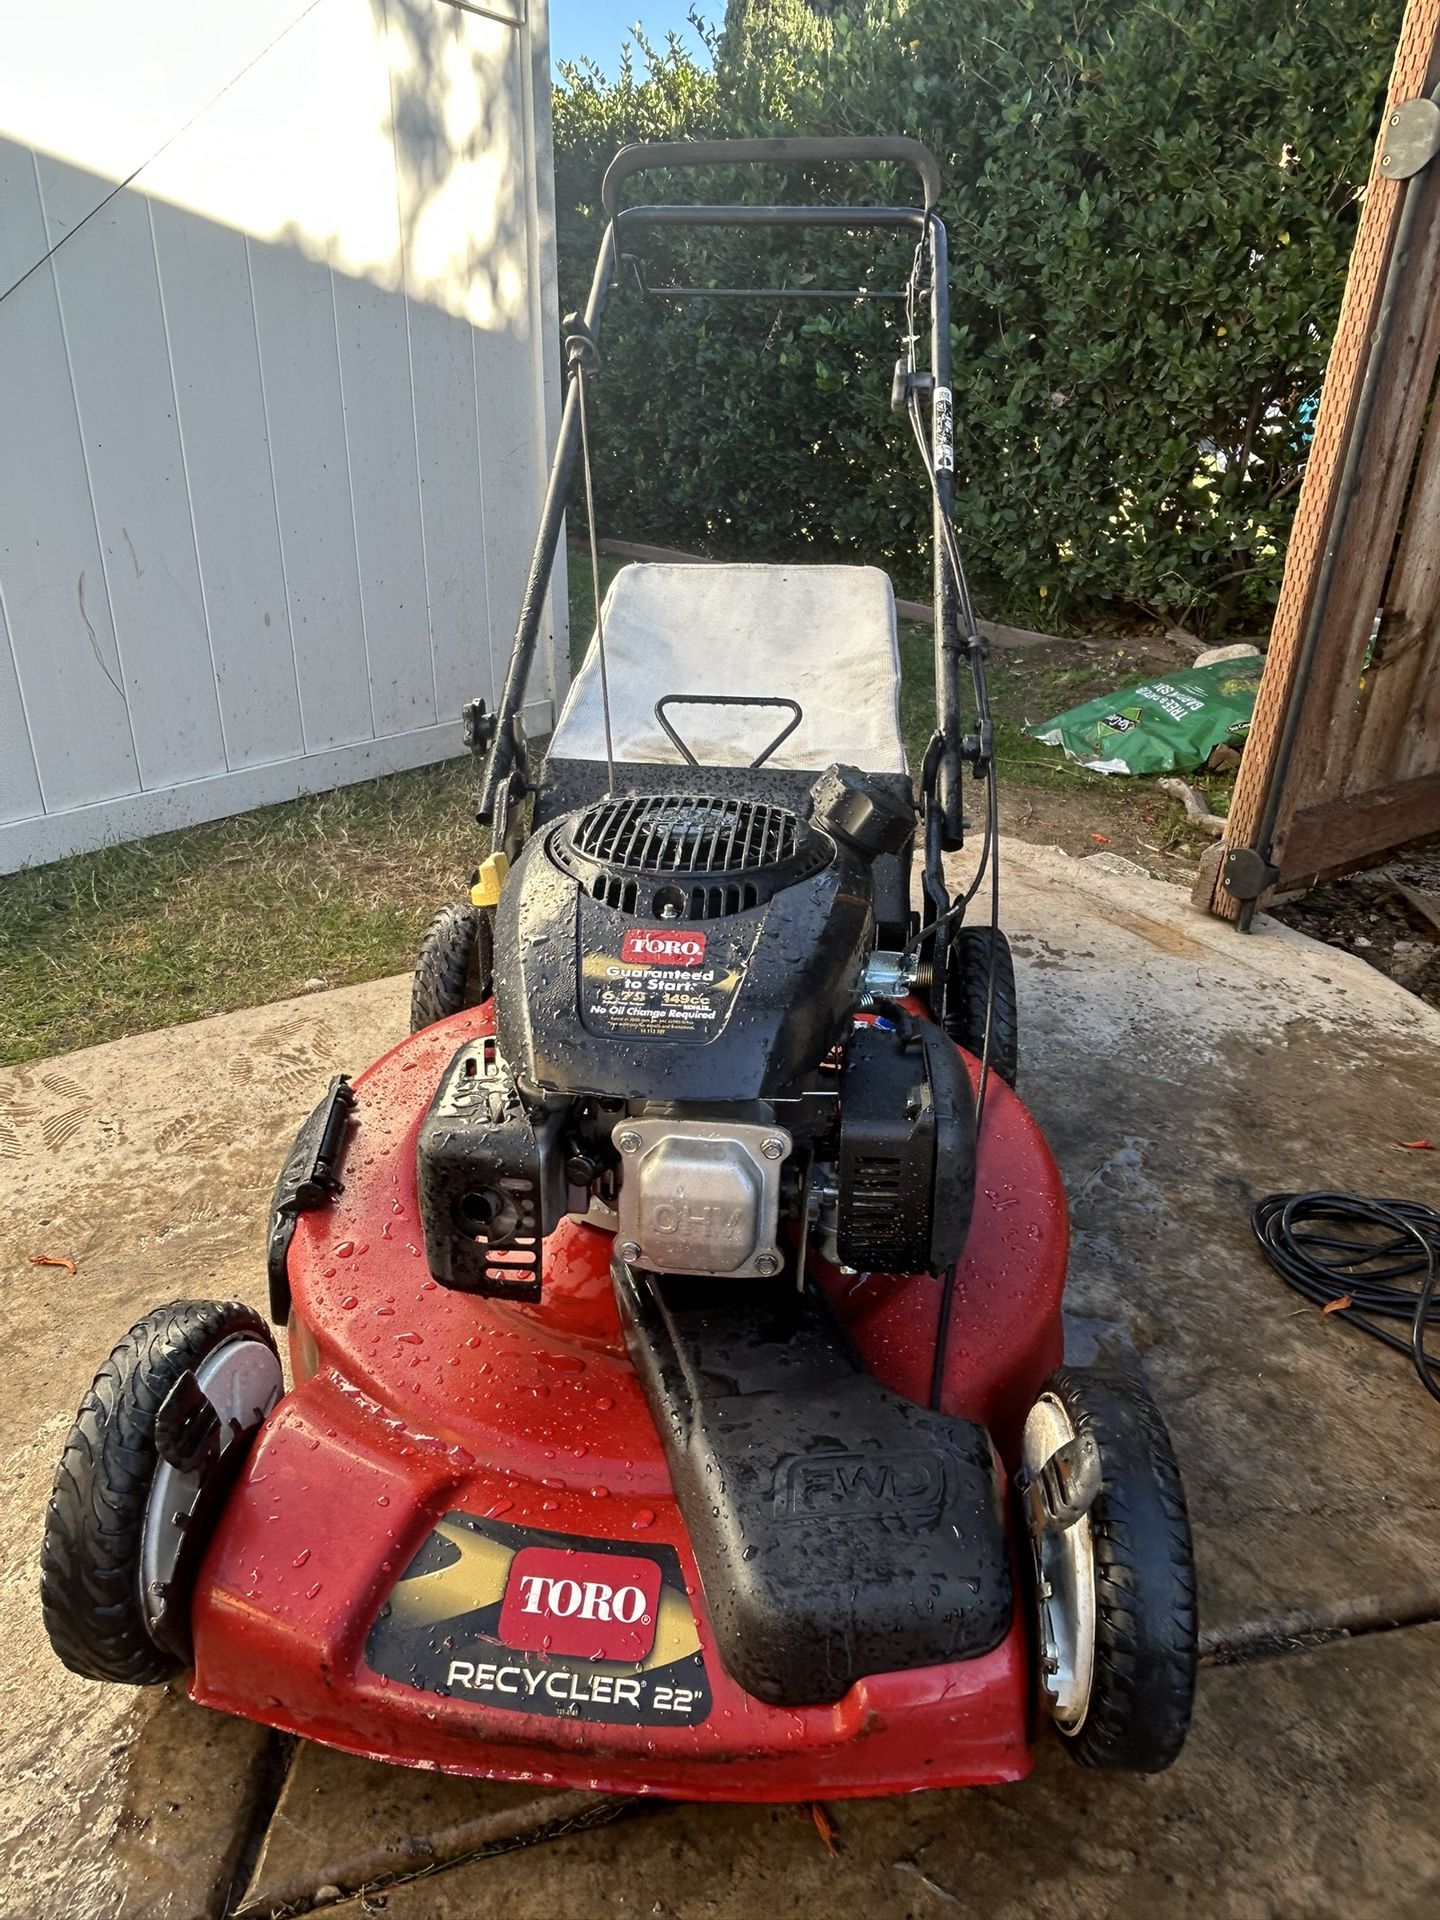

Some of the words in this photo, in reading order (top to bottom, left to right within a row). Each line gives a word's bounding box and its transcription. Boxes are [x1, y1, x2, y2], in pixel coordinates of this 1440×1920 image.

[1161, 699, 1188, 722] TREE
[606, 966, 714, 982] Guaranteed
[624, 979, 642, 990] to
[662, 993, 710, 1005] 149cc
[590, 1005, 607, 1014] No
[609, 1006, 625, 1015] Oil
[627, 1007, 666, 1019] Change
[669, 1010, 716, 1020] Required
